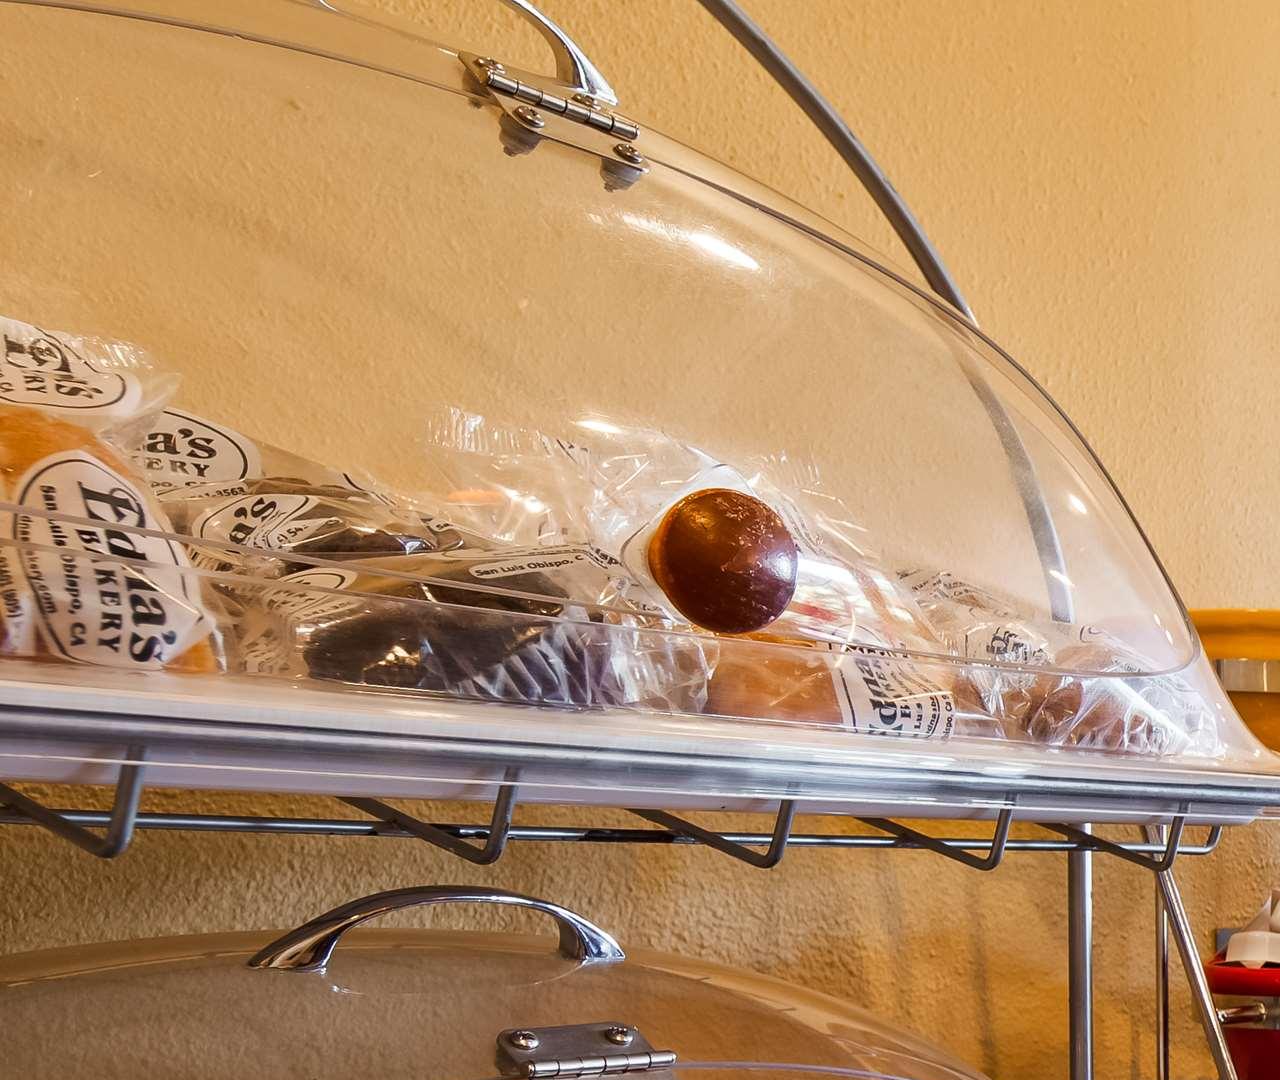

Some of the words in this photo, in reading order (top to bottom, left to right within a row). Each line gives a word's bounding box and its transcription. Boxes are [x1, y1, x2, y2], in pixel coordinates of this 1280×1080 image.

[474, 567, 499, 577] San
[502, 564, 526, 574] Luis
[69, 622, 87, 647] CA
